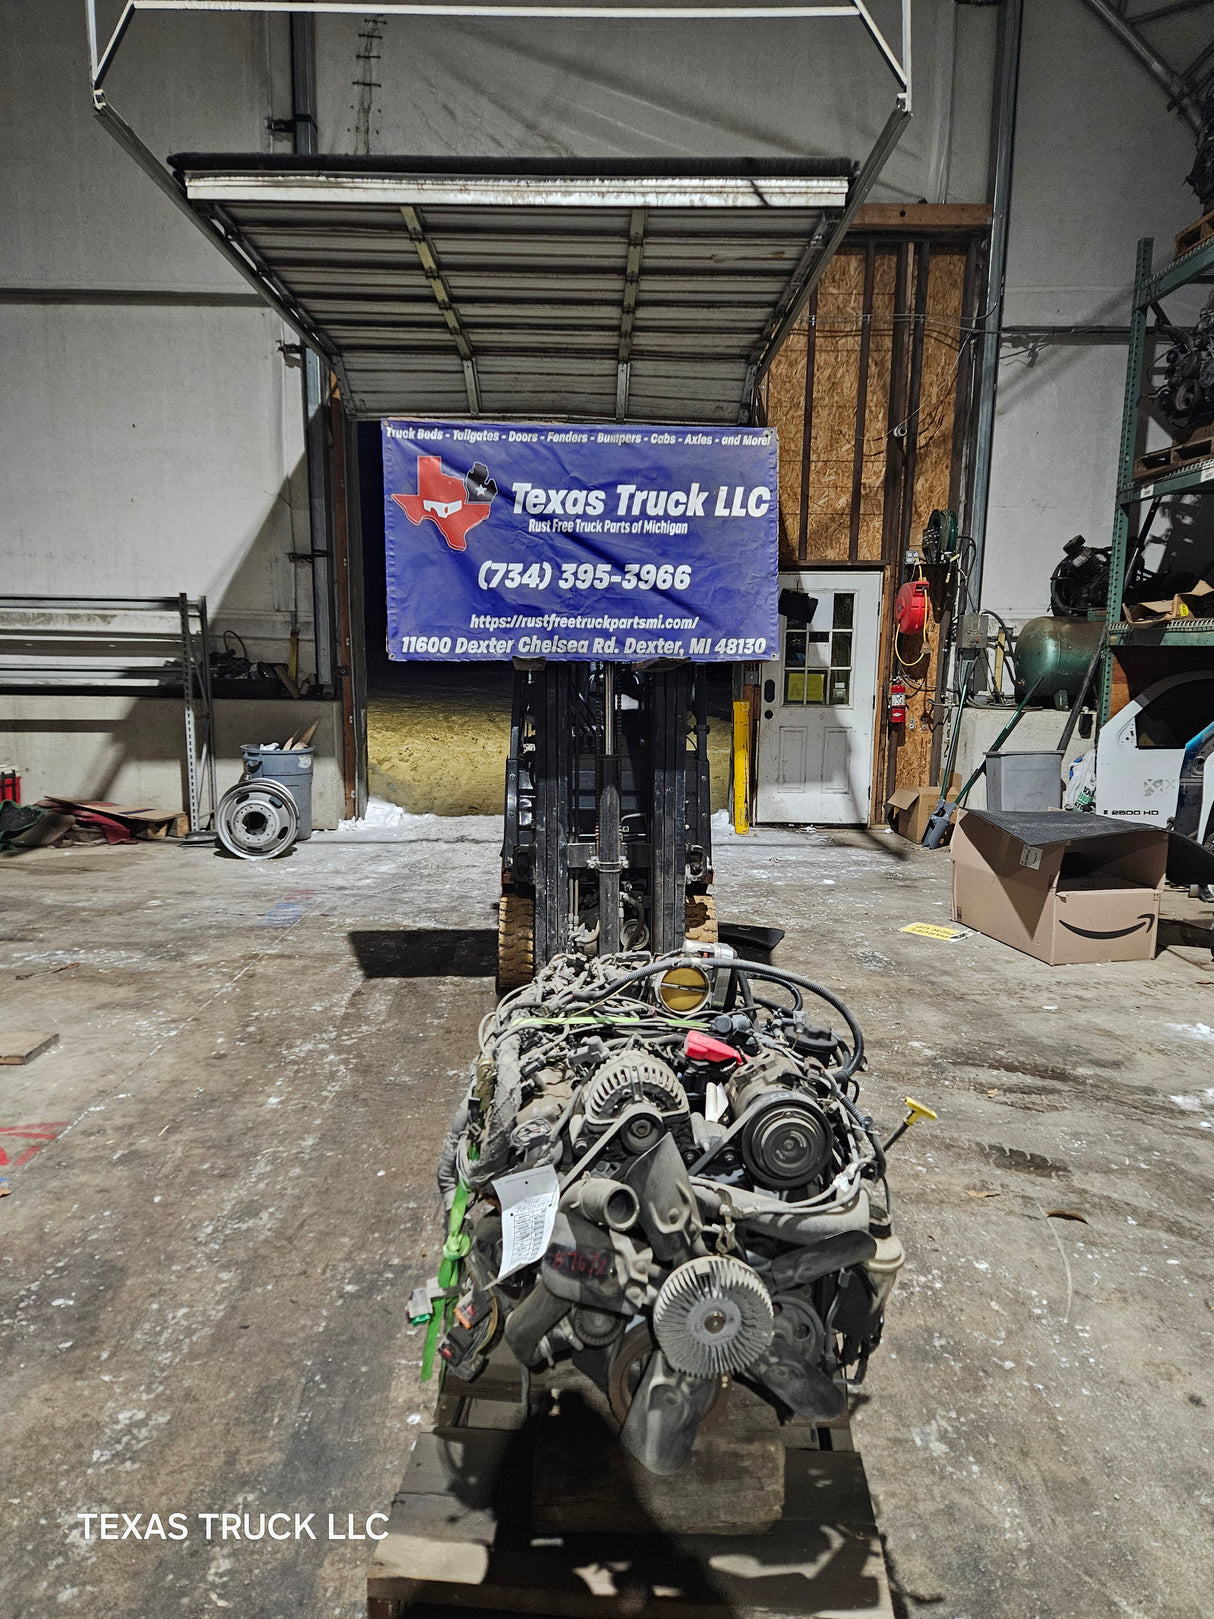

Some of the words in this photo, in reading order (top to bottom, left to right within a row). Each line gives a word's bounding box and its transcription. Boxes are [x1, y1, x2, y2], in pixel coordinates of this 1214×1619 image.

[386, 427, 416, 440] Truck
[417, 427, 443, 441] Beds
[452, 428, 500, 444] Tailgates
[508, 430, 539, 443] Doors
[547, 431, 589, 444] Fenders
[596, 431, 642, 446] Bumpers
[650, 432, 677, 445] Cabs
[684, 432, 713, 446] Axles
[721, 435, 741, 446] and
[742, 434, 772, 447] More!
[512, 482, 606, 515] Texas
[617, 483, 709, 516] Truck
[713, 485, 771, 518] LLC
[529, 519, 550, 532] Rust
[552, 519, 574, 532] Free
[576, 519, 602, 532] Truck
[604, 520, 630, 533] Parts
[632, 520, 642, 533] of
[644, 520, 688, 535] Michigan
[479, 560, 552, 590] (734)
[559, 564, 691, 590] 395-3966
[470, 614, 699, 632] https://rustfreetruckpartsmi.com/
[400, 636, 451, 655] 11600
[455, 637, 514, 656] Dexter
[517, 635, 588, 654] Chelsea
[592, 637, 619, 656] Rd.
[624, 638, 687, 658] Dexter,
[689, 637, 712, 655] MI
[713, 637, 767, 655] 48130
